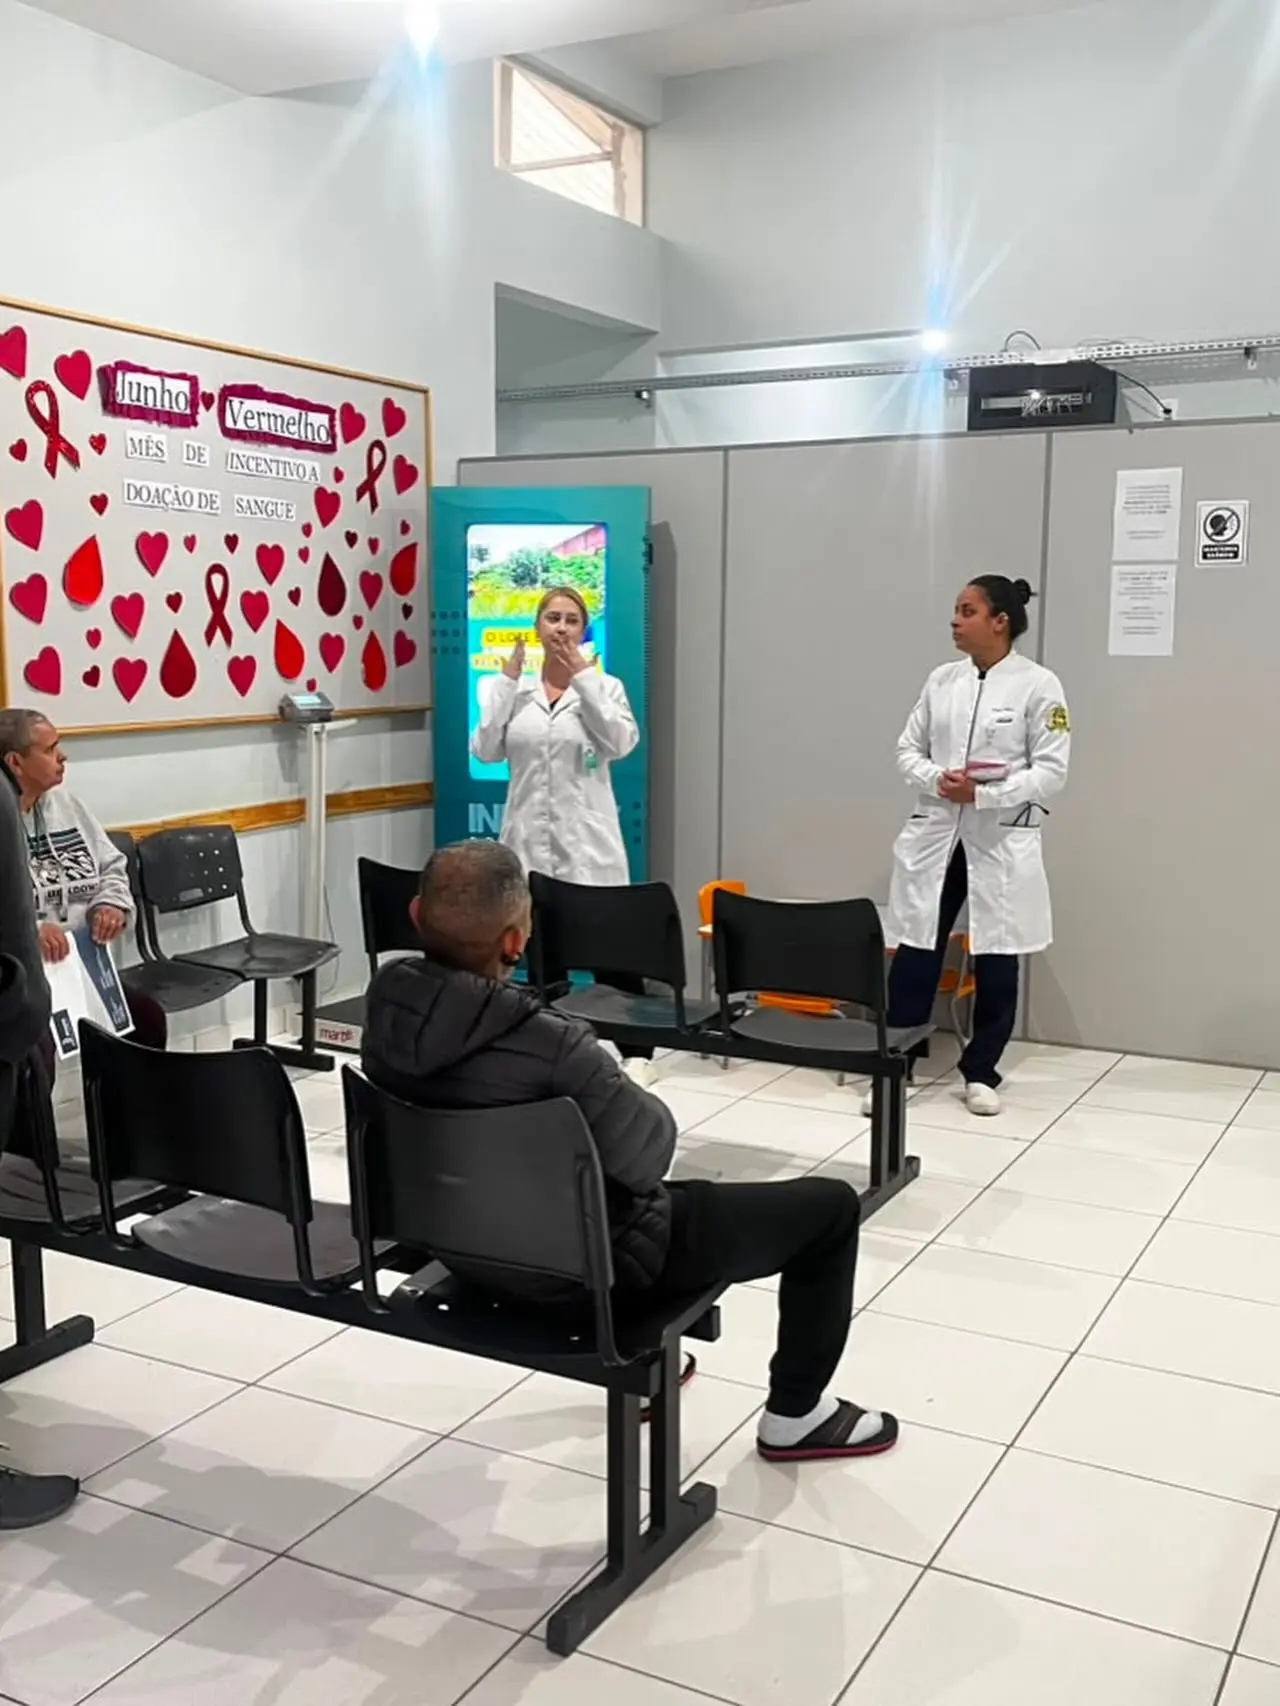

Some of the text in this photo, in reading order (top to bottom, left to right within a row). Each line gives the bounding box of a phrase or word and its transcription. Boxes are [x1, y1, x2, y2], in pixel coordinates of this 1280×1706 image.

[117, 372, 330, 443] Junho Vermelho
[130, 434, 319, 482] MÊS DE INCENTIVO A
[126, 483, 294, 519] DOAÇÃO DE SANGUE
